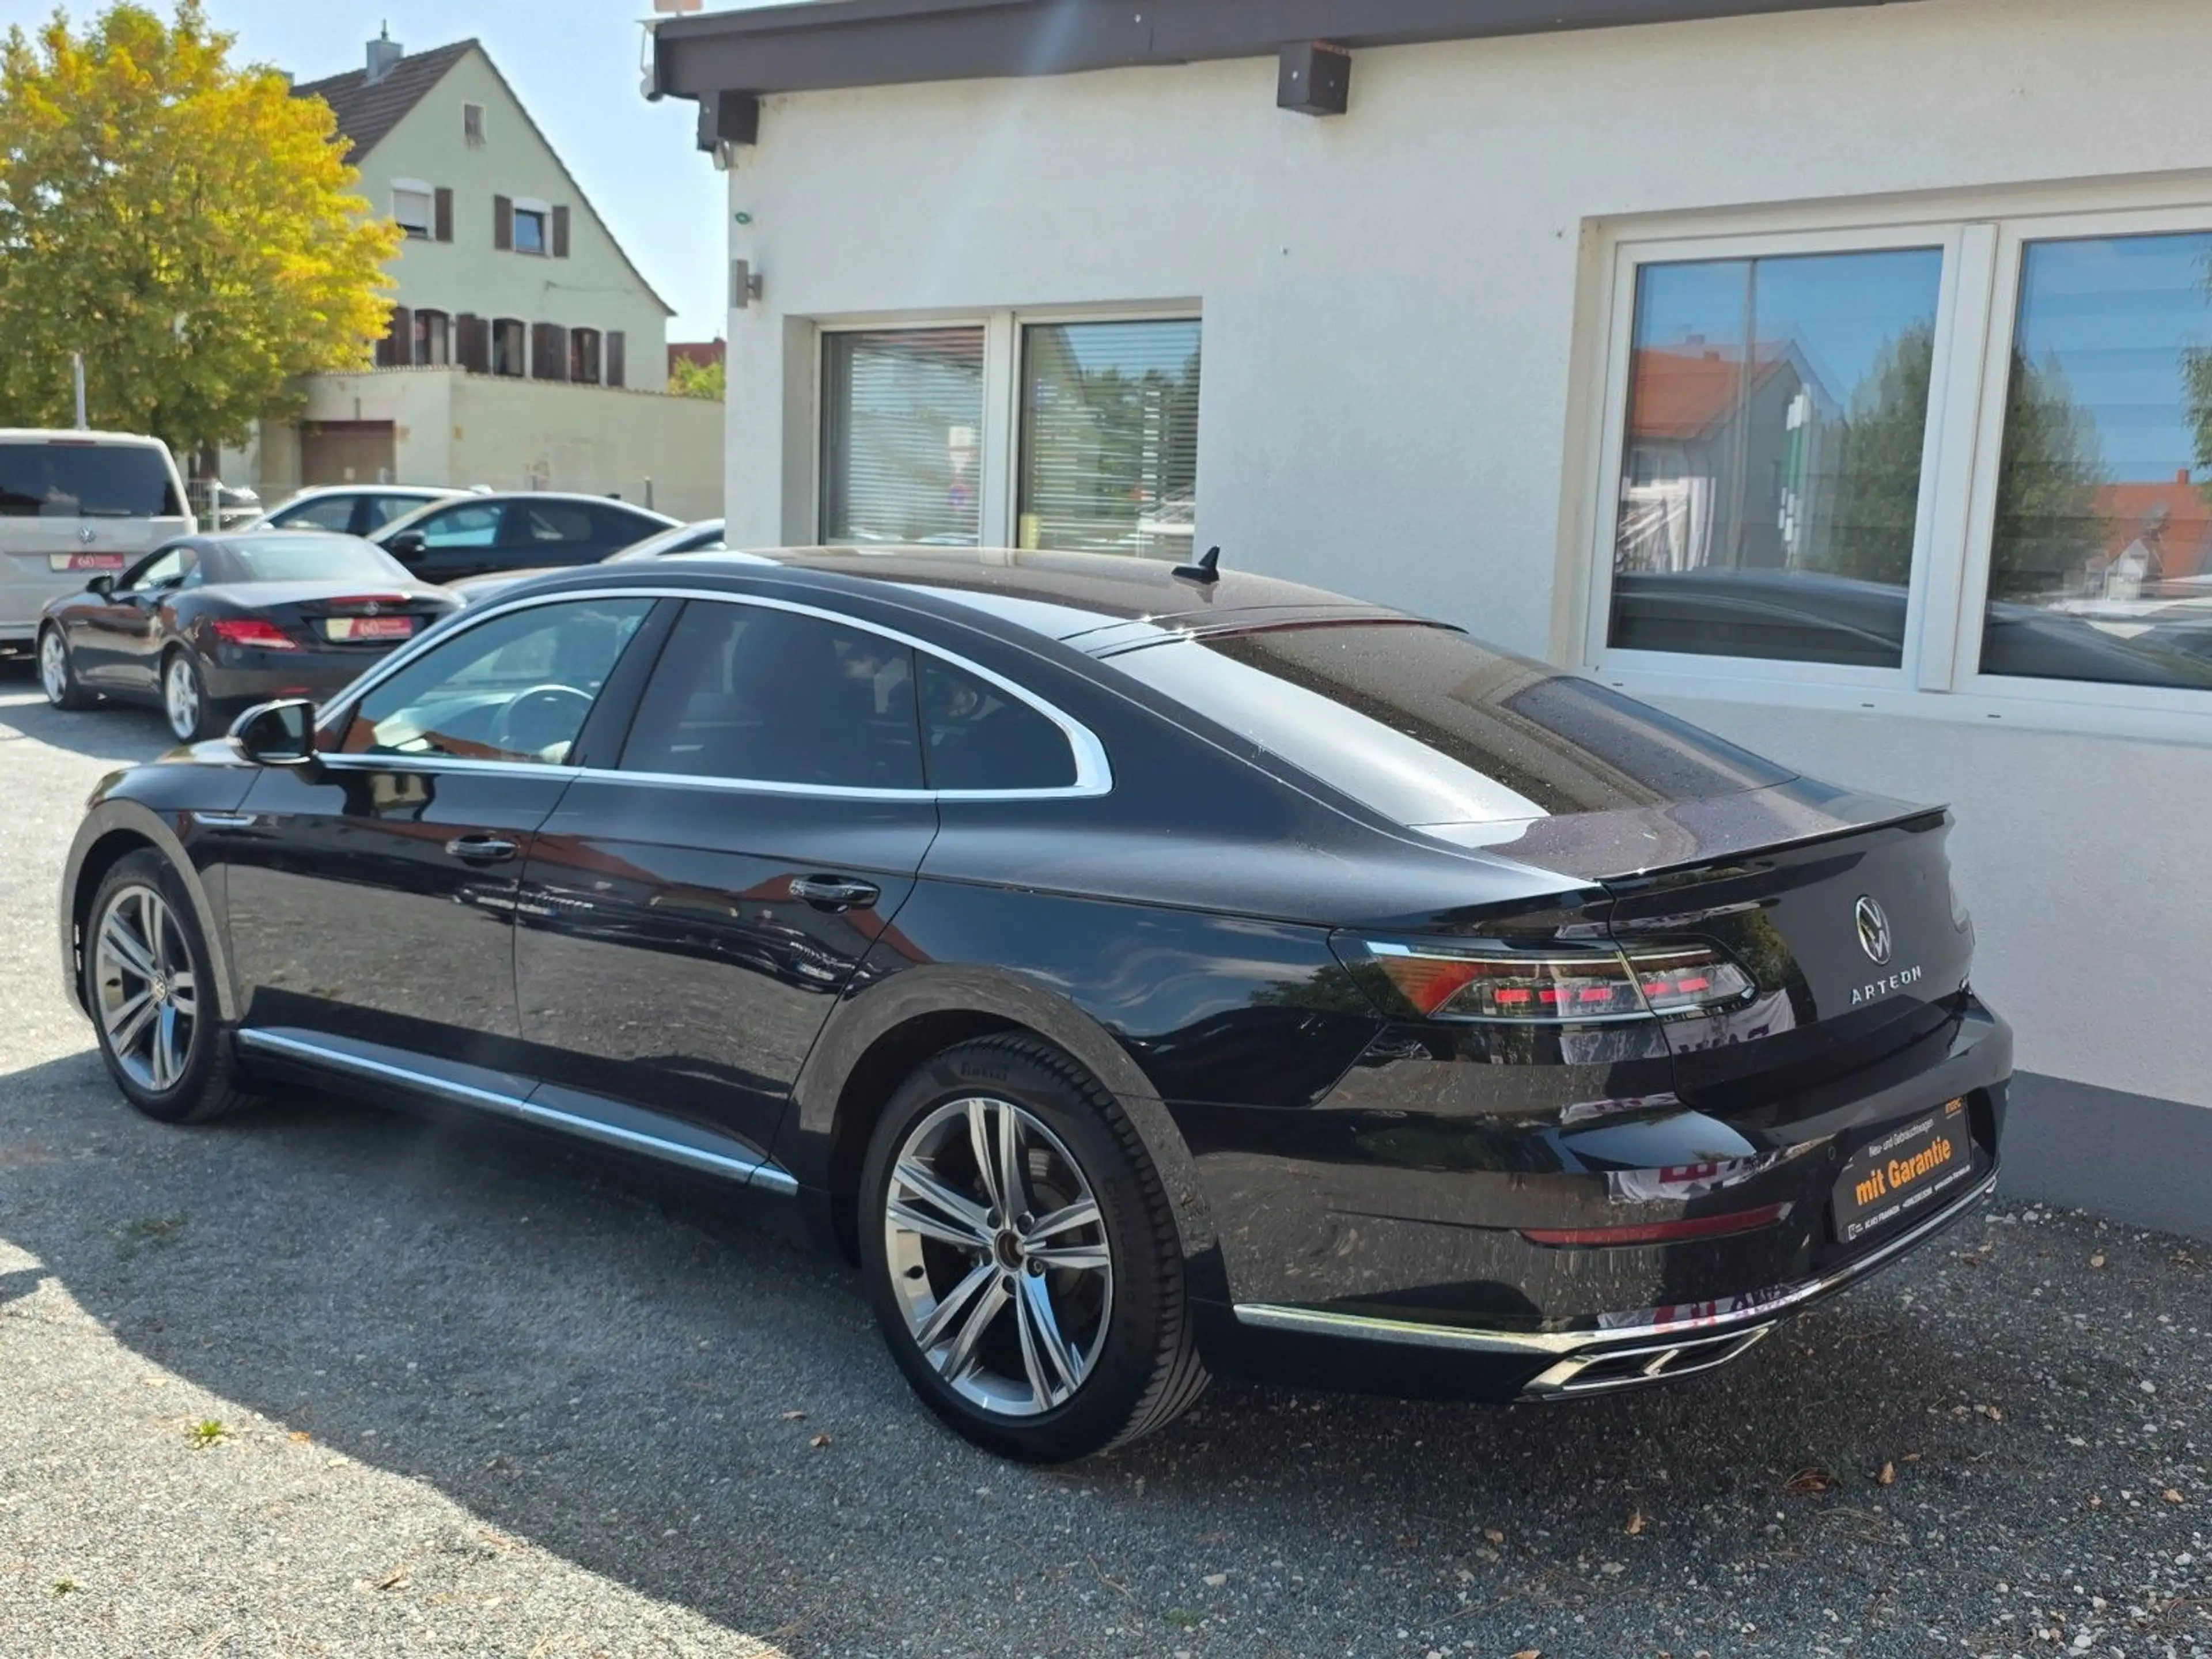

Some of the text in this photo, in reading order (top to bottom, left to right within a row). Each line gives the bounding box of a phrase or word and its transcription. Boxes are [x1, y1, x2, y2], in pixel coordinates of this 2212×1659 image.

[1851, 965, 1922, 1004] ARTEON
[1856, 1168, 1886, 1206] mit
[1888, 1136, 1952, 1188] Garantie
